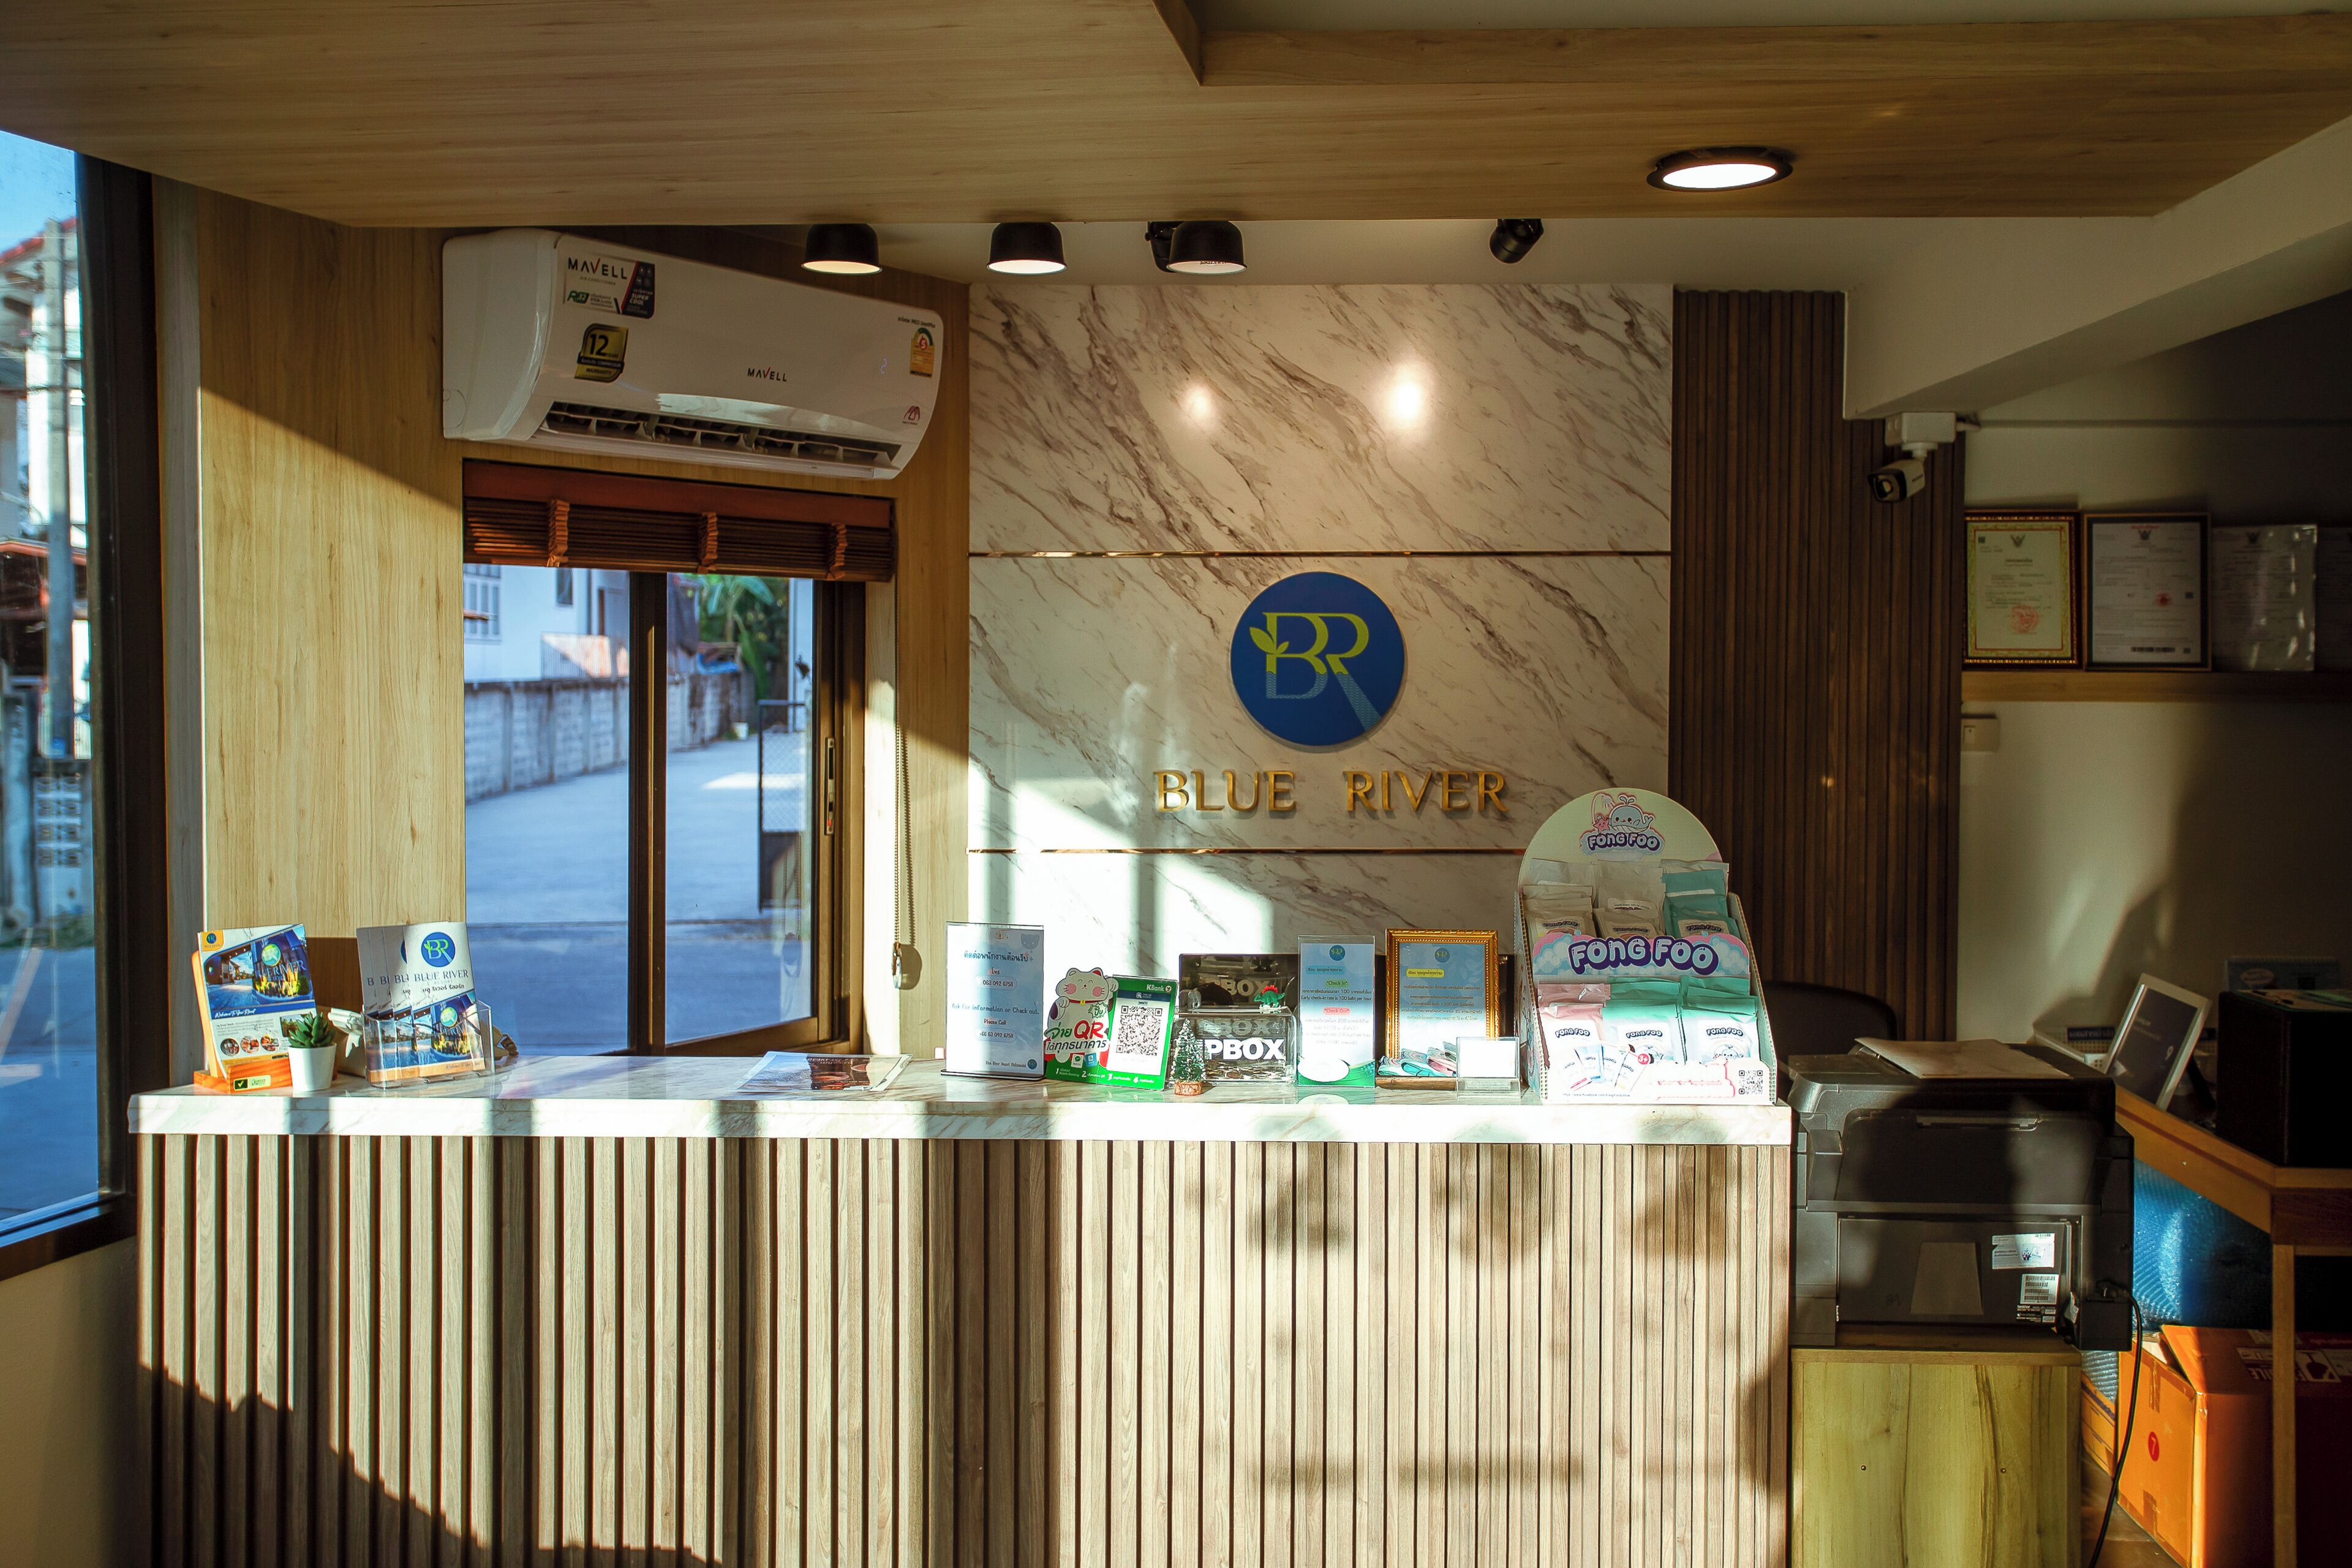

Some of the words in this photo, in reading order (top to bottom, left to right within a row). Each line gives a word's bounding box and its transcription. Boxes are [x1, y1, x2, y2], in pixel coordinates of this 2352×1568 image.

[568, 257, 628, 279] MAVELL
[590, 334, 608, 356] 12
[747, 367, 787, 382] MAVELL
[1153, 770, 1296, 812] BLUE
[1343, 770, 1509, 813] RIVER
[414, 972, 440, 981] BLUE
[443, 970, 469, 979] RIVER
[1045, 1022, 1072, 1039] จ่าย
[1074, 1019, 1104, 1040] QR
[1046, 1040, 1107, 1054] ได้ทุกธนาคาร
